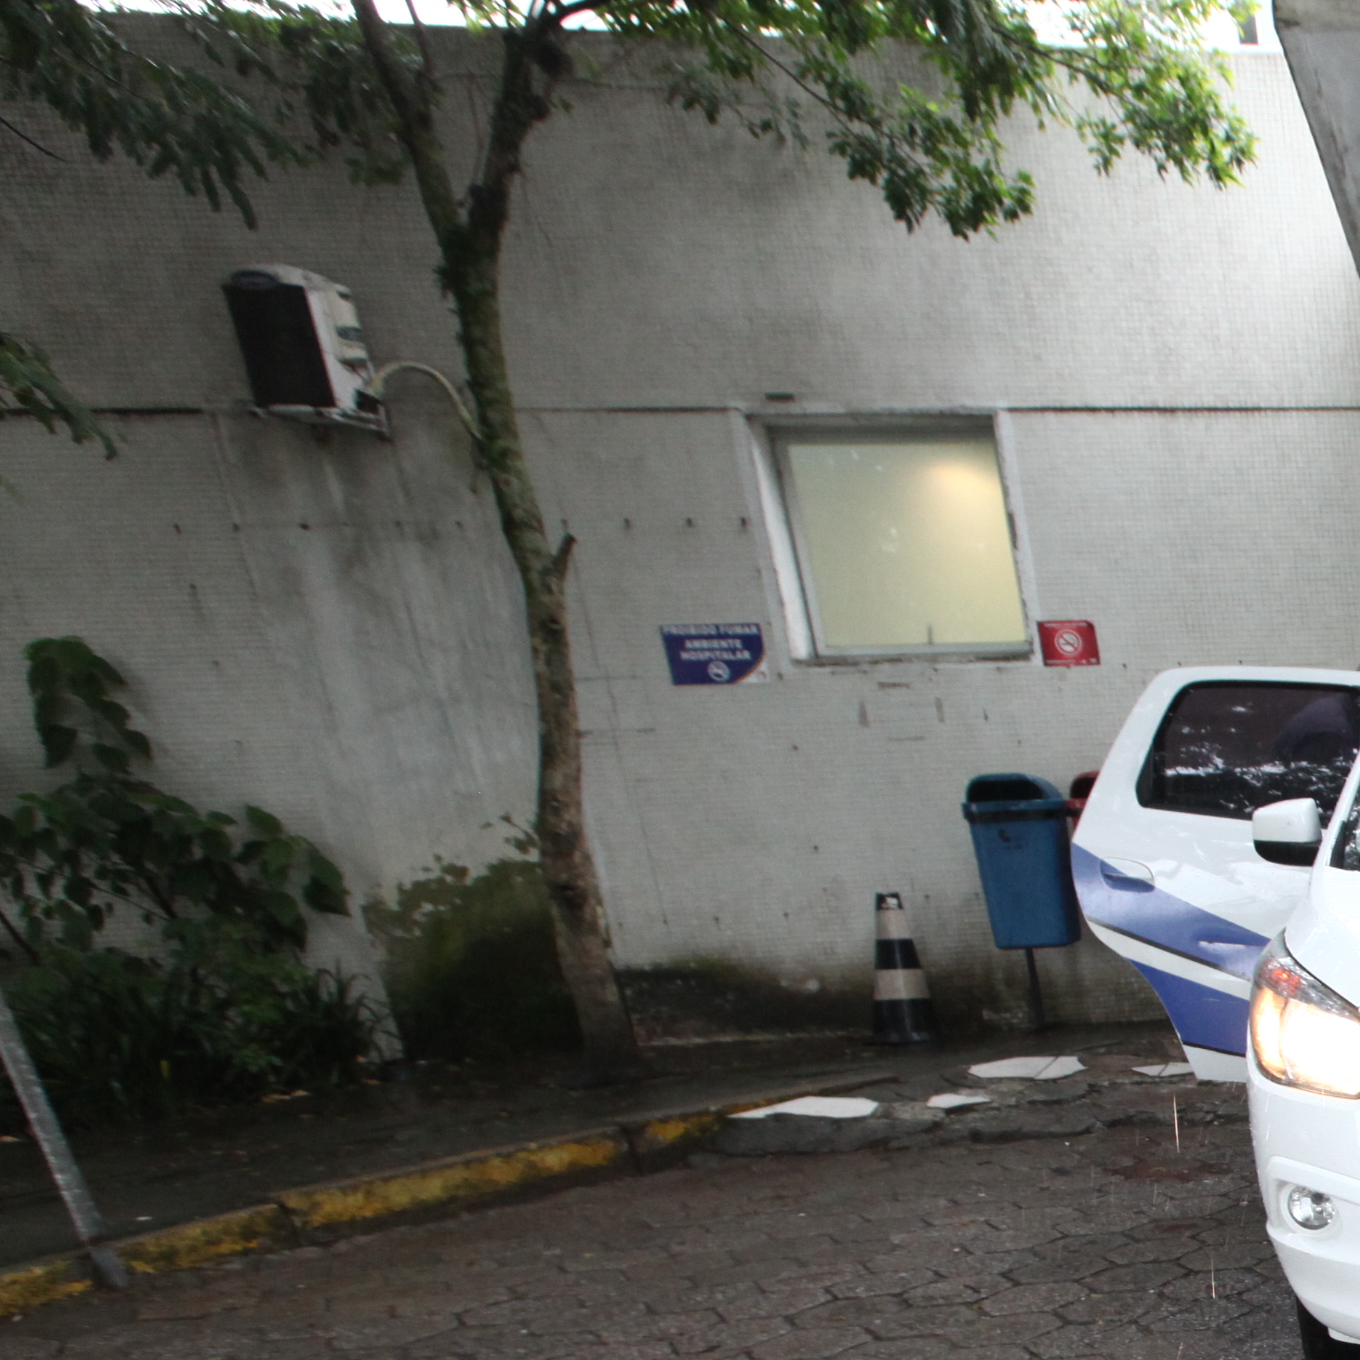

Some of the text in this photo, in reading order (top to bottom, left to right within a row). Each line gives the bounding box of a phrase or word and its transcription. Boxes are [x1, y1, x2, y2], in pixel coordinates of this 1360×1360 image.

[718, 623, 759, 635] FUMAR
[684, 639, 742, 650] AMBIENTE
[680, 649, 751, 661] HOSPITALAR
